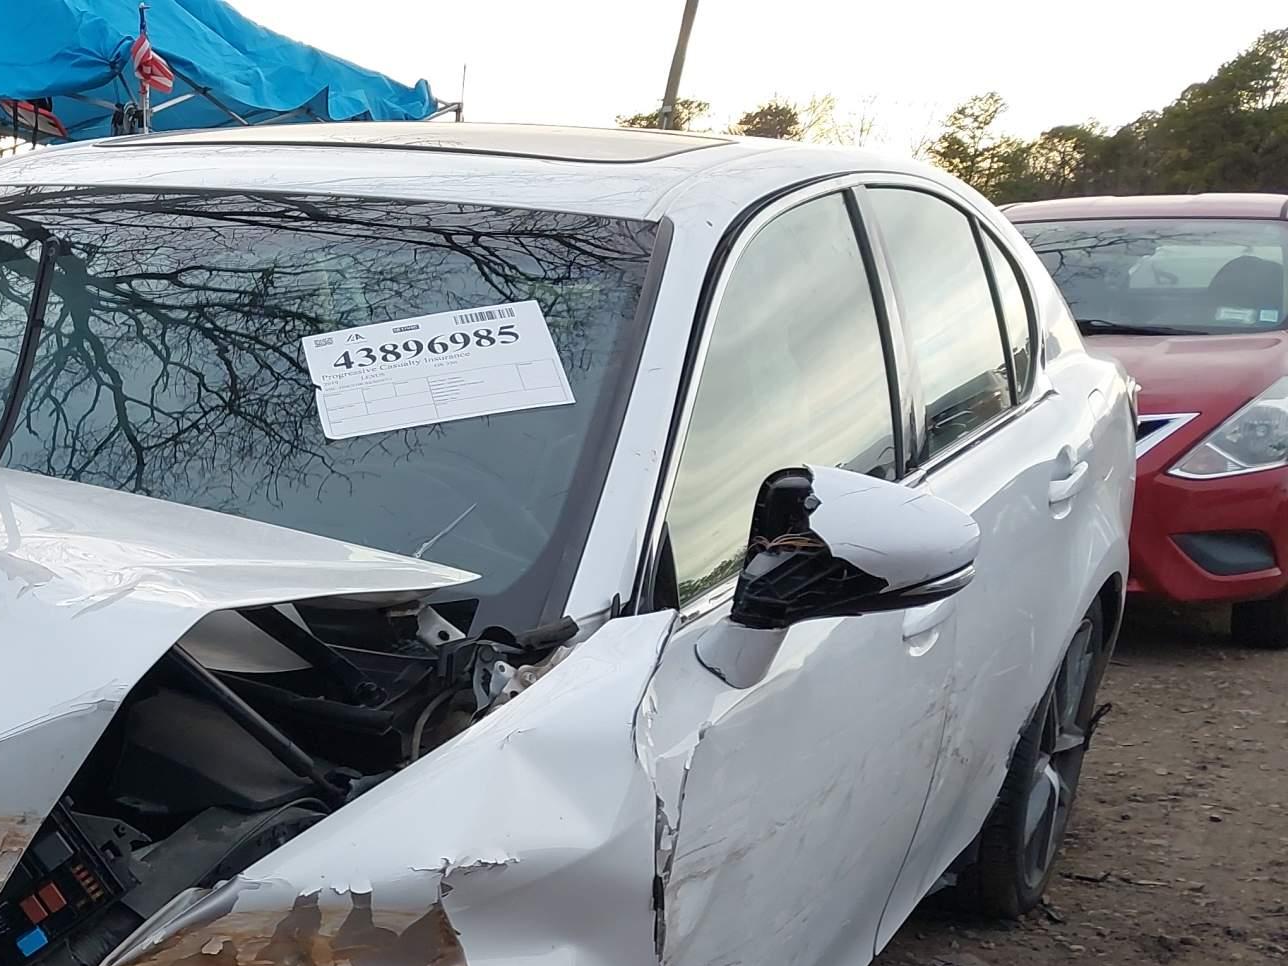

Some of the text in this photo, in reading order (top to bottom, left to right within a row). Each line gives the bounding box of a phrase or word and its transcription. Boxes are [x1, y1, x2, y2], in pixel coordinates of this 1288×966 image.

[333, 325, 520, 369] 43896985
[321, 367, 377, 381] Progressive
[379, 358, 421, 370] Casualty
[423, 352, 471, 363] Insurance
